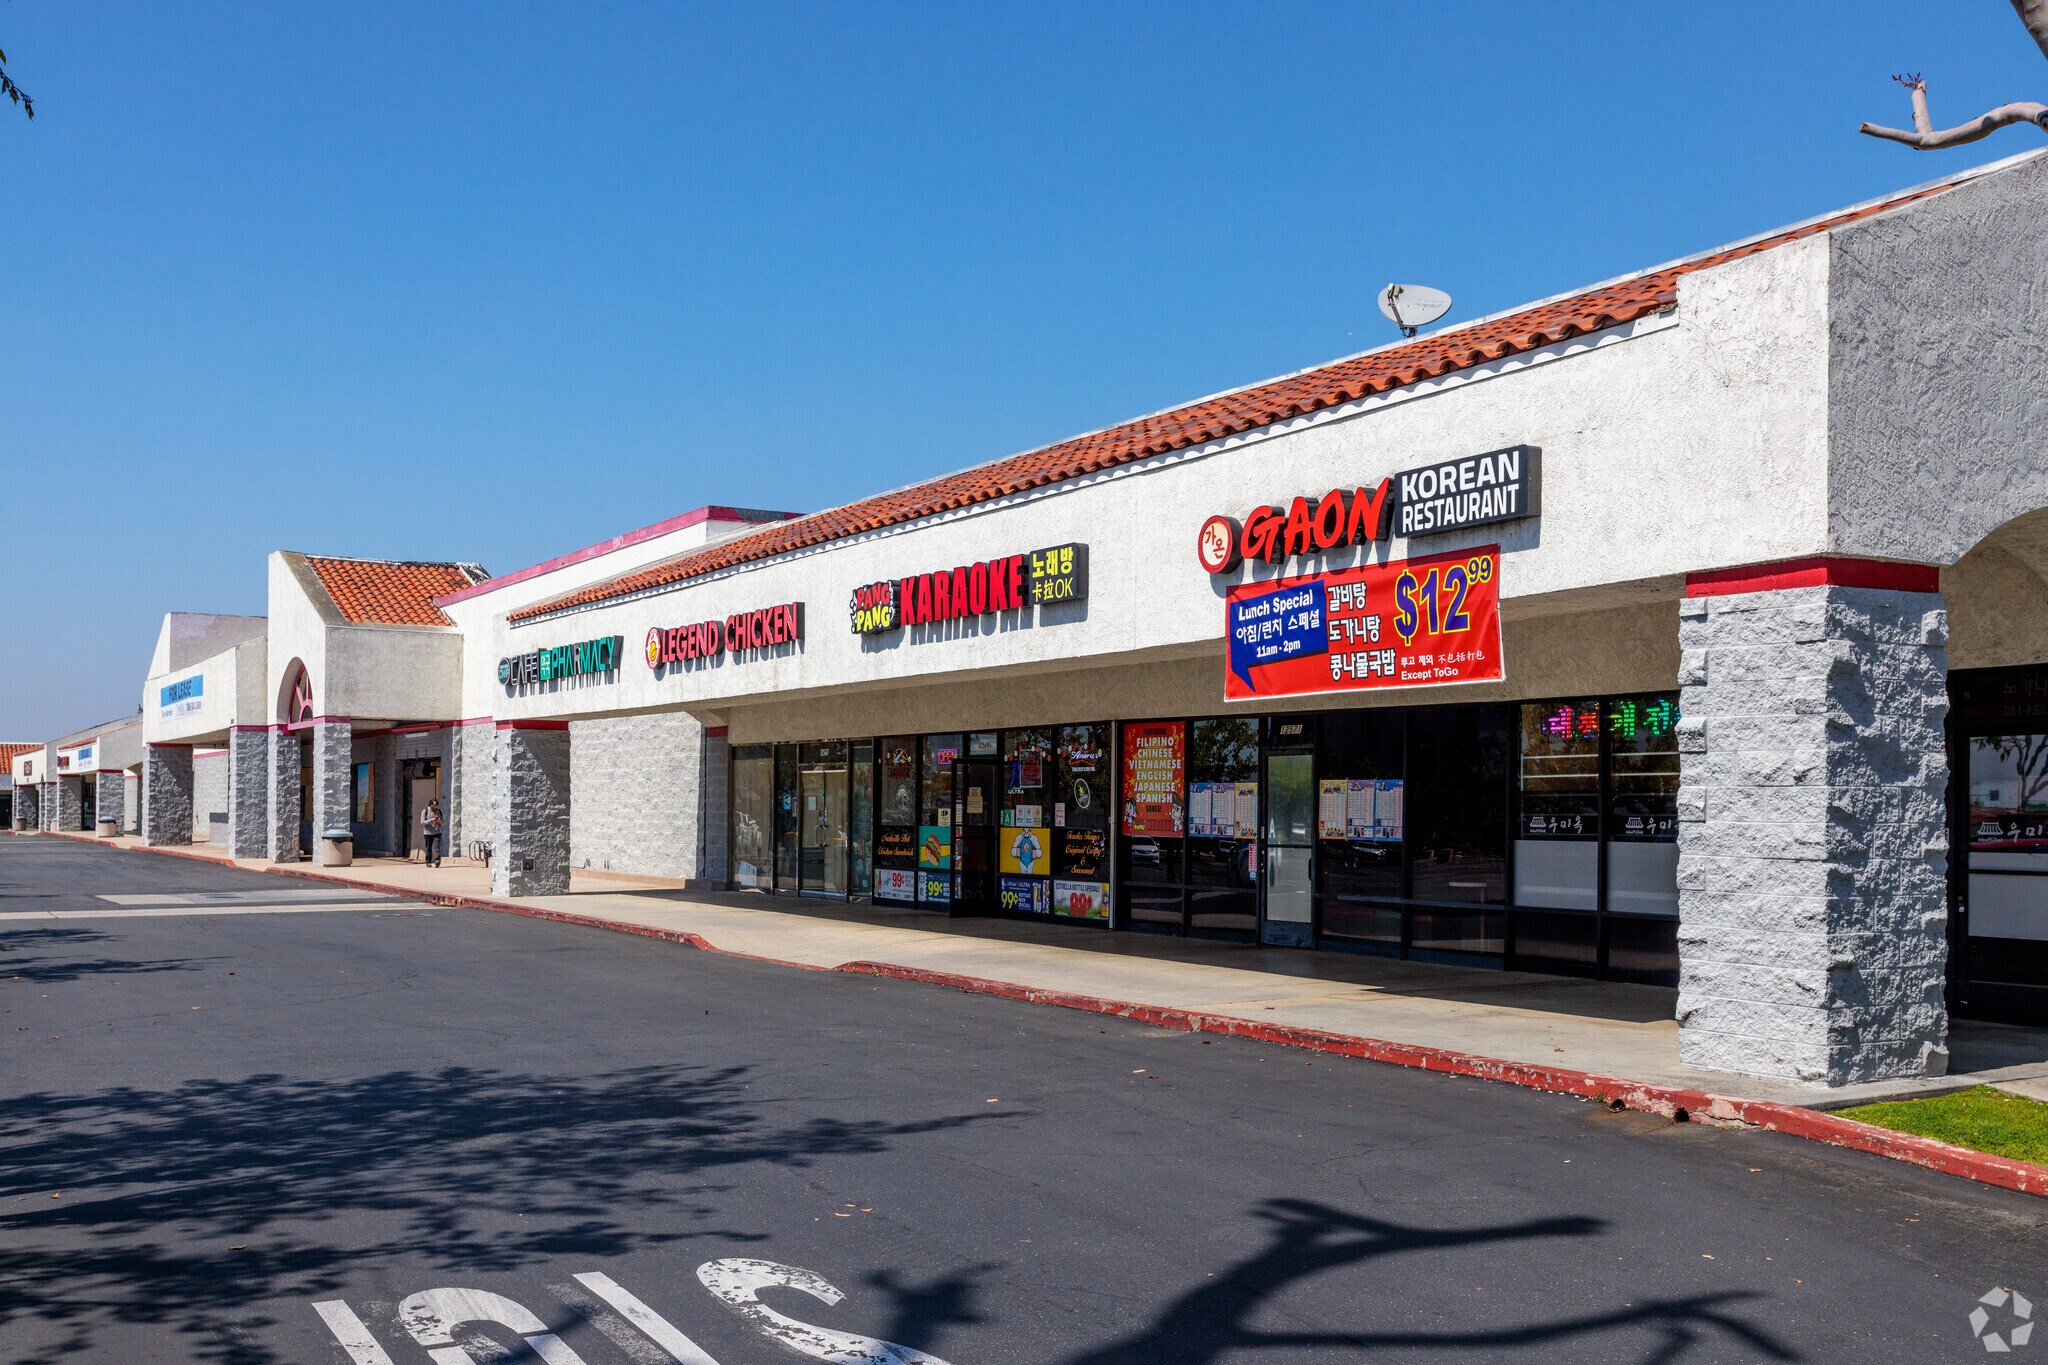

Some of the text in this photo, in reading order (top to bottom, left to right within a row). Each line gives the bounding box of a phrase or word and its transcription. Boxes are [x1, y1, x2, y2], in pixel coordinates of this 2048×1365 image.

[1402, 451, 1519, 502] KOREAN
[1240, 477, 1390, 564] GAON
[1402, 483, 1519, 533] RESTAURANT
[1204, 525, 1226, 559] 가온
[1031, 547, 1073, 578] 노래방
[856, 582, 891, 610] PANG
[900, 553, 1023, 626] KARAOKE
[1031, 577, 1073, 603] 卡拉OK
[1327, 582, 1366, 612] 갈비탕
[1393, 555, 1492, 646] $12 99
[1238, 588, 1313, 621] Lunch Special
[856, 605, 891, 632] PANG
[1236, 608, 1320, 644] 아침/런치 스페셜
[1328, 615, 1380, 644] 도가니탕
[661, 602, 797, 663] LEGEND CHICKEN
[552, 635, 615, 679] PHARMACY
[1256, 645, 1278, 658] 11am
[1283, 640, 1301, 654] 2pm
[510, 652, 538, 686] CAFE
[1330, 649, 1396, 680] 콩나물국밥
[1401, 667, 1458, 680] Except ToGo
[1136, 736, 1174, 748] FILIPINO
[1137, 748, 1173, 758] CHINESE
[1129, 759, 1181, 769] VIETNAMESE
[1136, 771, 1173, 781] ENGLISH
[1133, 782, 1175, 792] JAPANESE
[1136, 793, 1173, 803] SPANISH
[1549, 815, 1583, 834] 우미옥
[1646, 817, 1679, 835] 우미
[2006, 821, 2048, 843] 우미
[927, 880, 943, 897] 99¢
[1001, 890, 1019, 909] 99¢
[1069, 892, 1093, 916] 99¢
